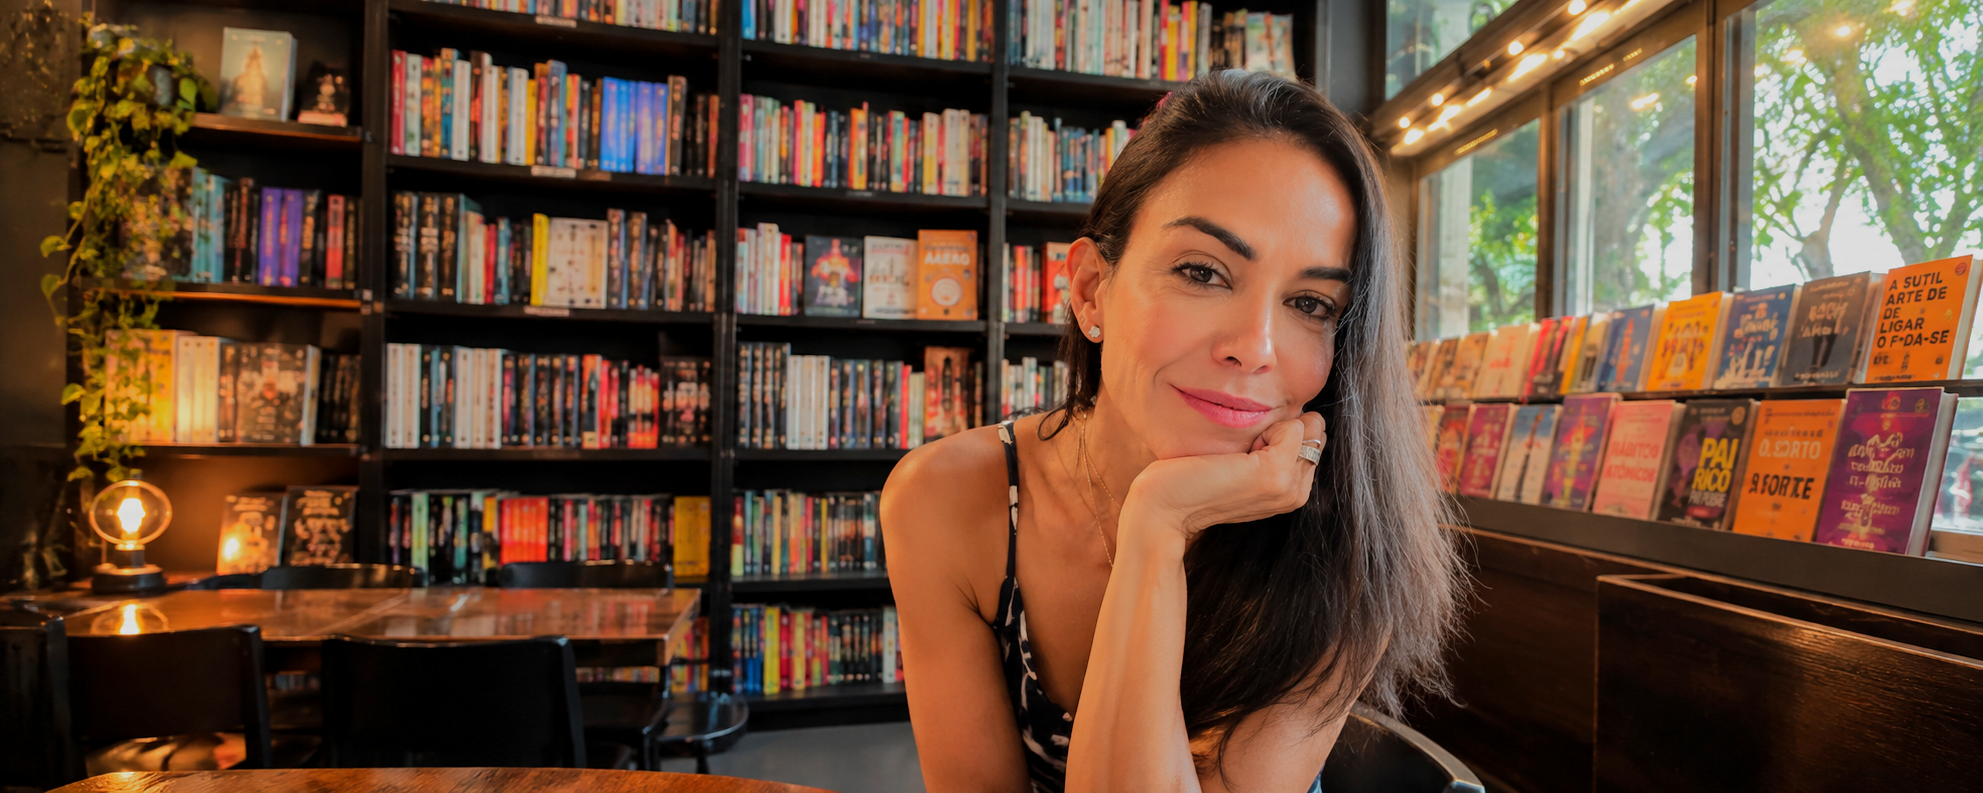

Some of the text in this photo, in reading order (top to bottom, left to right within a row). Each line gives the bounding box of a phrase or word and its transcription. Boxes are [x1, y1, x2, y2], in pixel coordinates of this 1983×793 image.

[1889, 271, 1943, 292] A SUTIL
[1885, 286, 1948, 306] ARTE DE
[1883, 307, 1901, 320] DE
[1879, 317, 1925, 334] LIGAR
[1877, 335, 1886, 348] O
[1698, 437, 1740, 470] PAI
[1692, 467, 1732, 493] RICO
